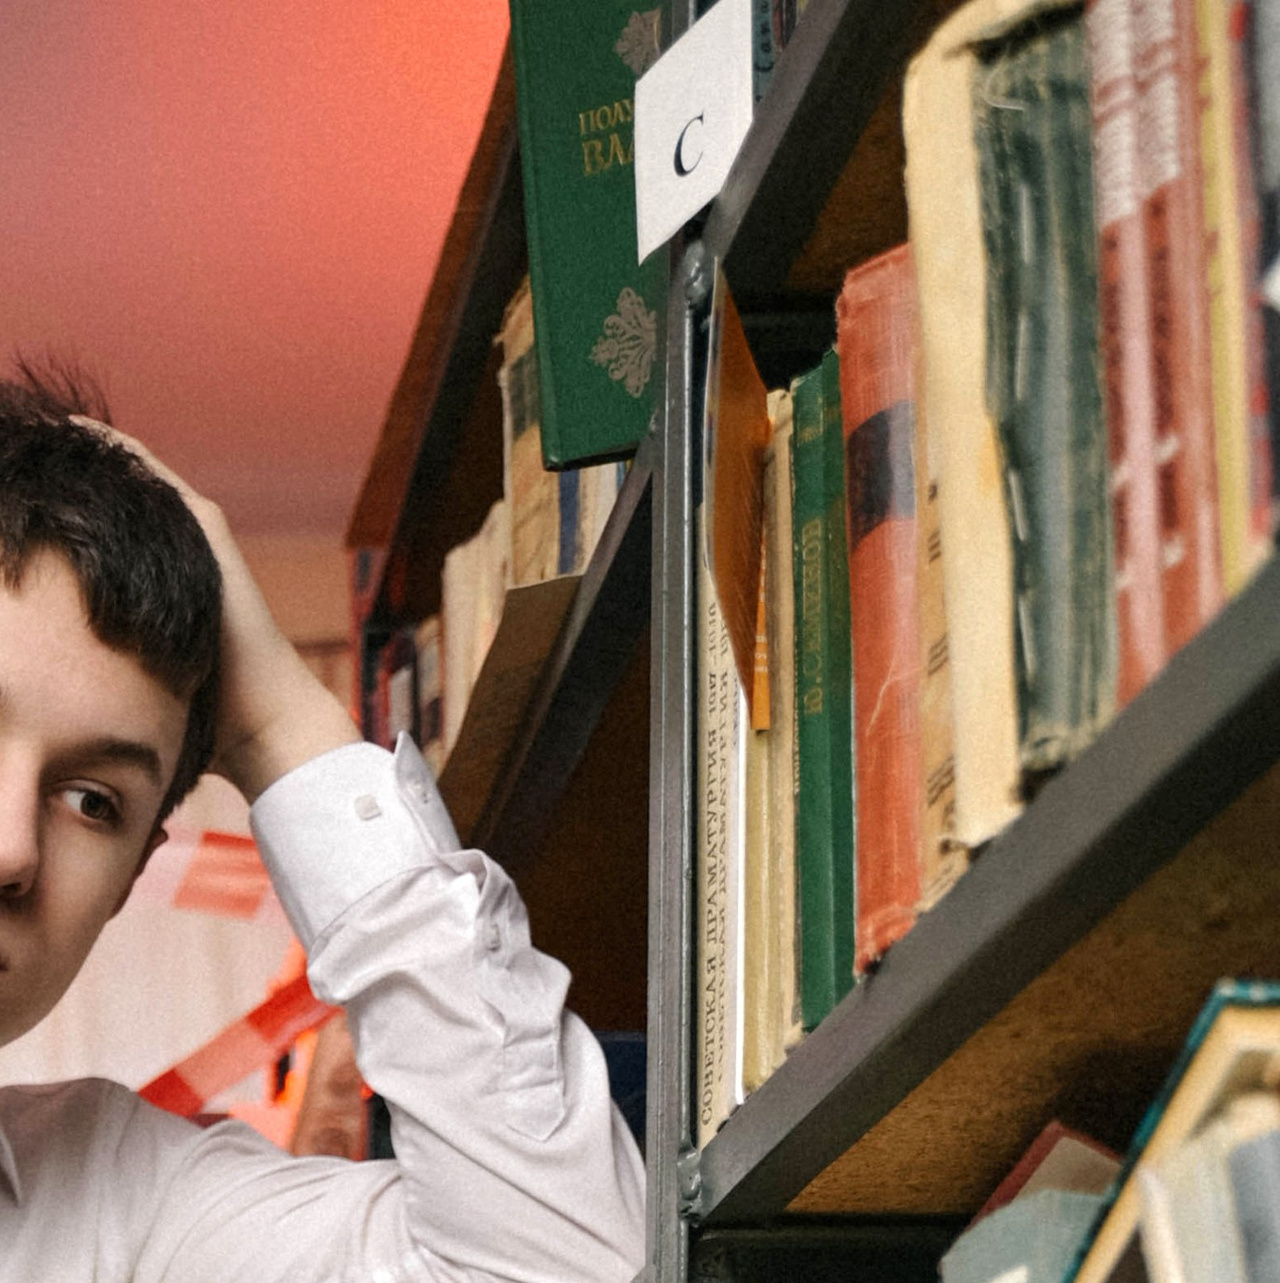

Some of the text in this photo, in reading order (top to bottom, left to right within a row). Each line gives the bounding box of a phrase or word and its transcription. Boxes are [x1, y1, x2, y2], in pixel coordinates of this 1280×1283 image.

[578, 98, 635, 136] ПОЛУ
[673, 114, 706, 177] С
[706, 730, 717, 944] ДРАМАТУРГИЯ
[701, 956, 716, 1125] СОВЕТСКАЯ
